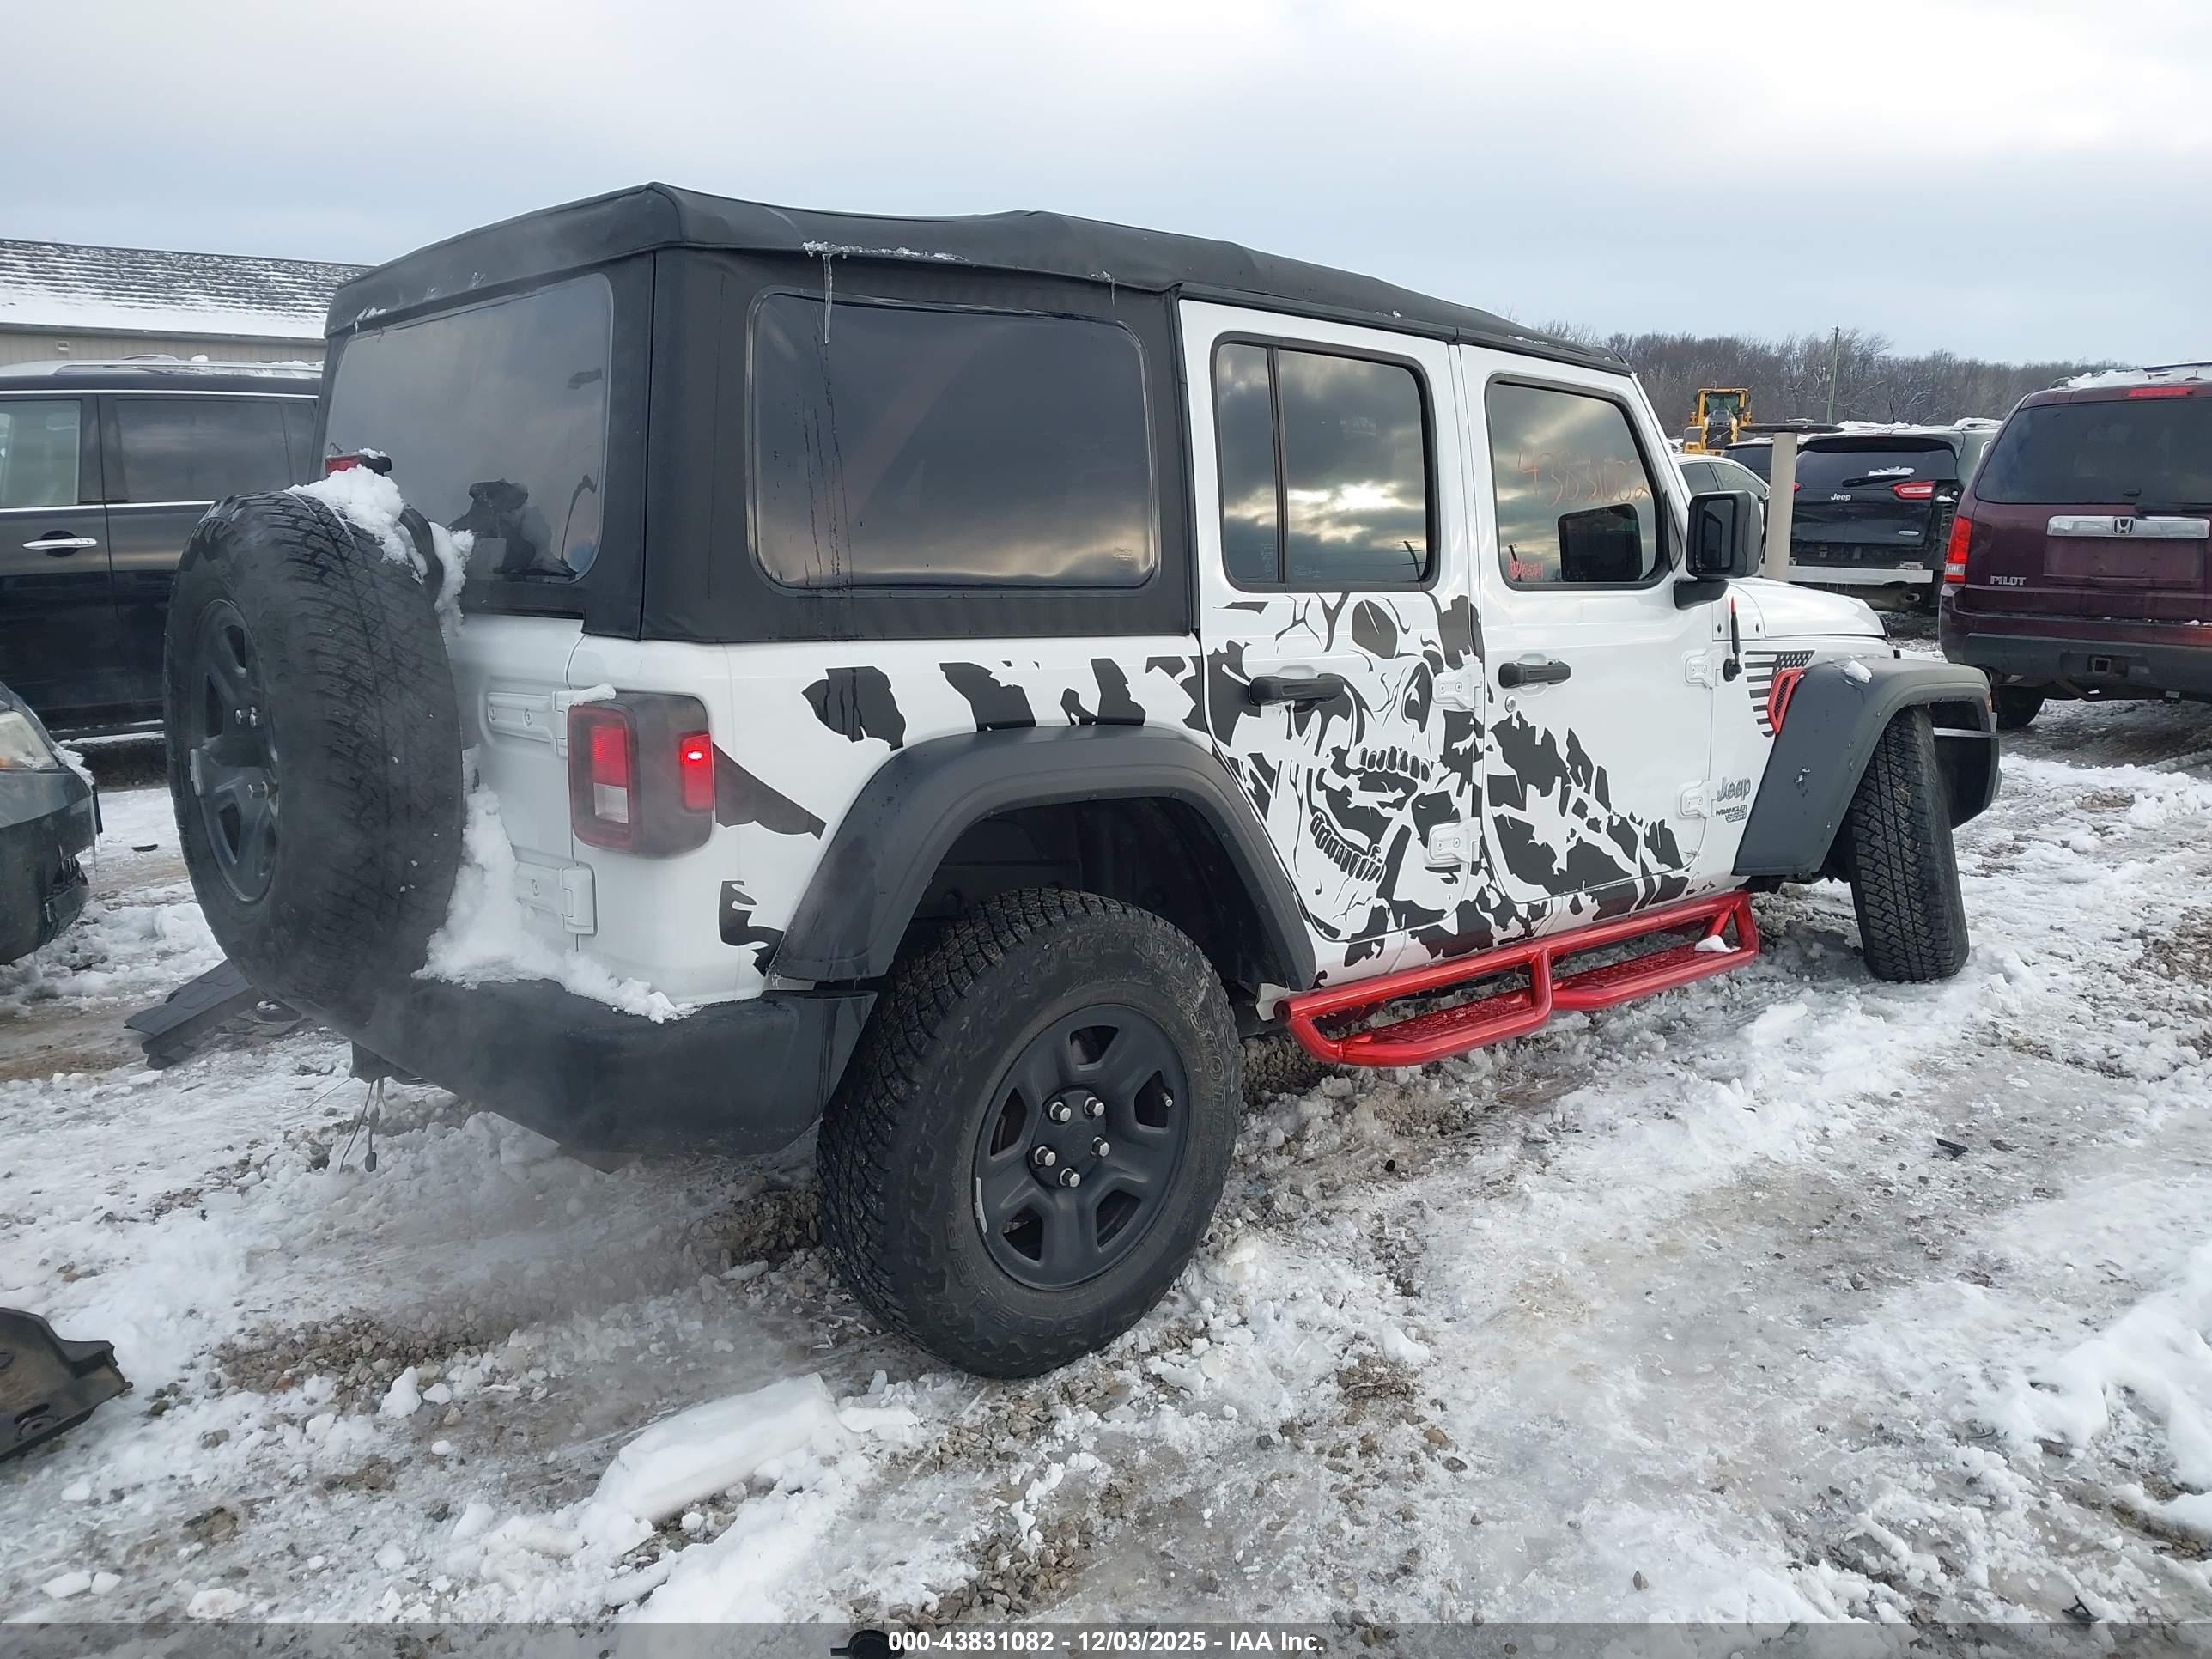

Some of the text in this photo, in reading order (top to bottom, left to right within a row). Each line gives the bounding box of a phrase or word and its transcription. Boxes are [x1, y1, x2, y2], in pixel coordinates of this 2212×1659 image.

[1830, 493, 1852, 502] Jeep
[1990, 575, 2027, 586] PILOT
[1717, 776, 1751, 802] Jeep
[1716, 804, 1748, 817] WRANGLER
